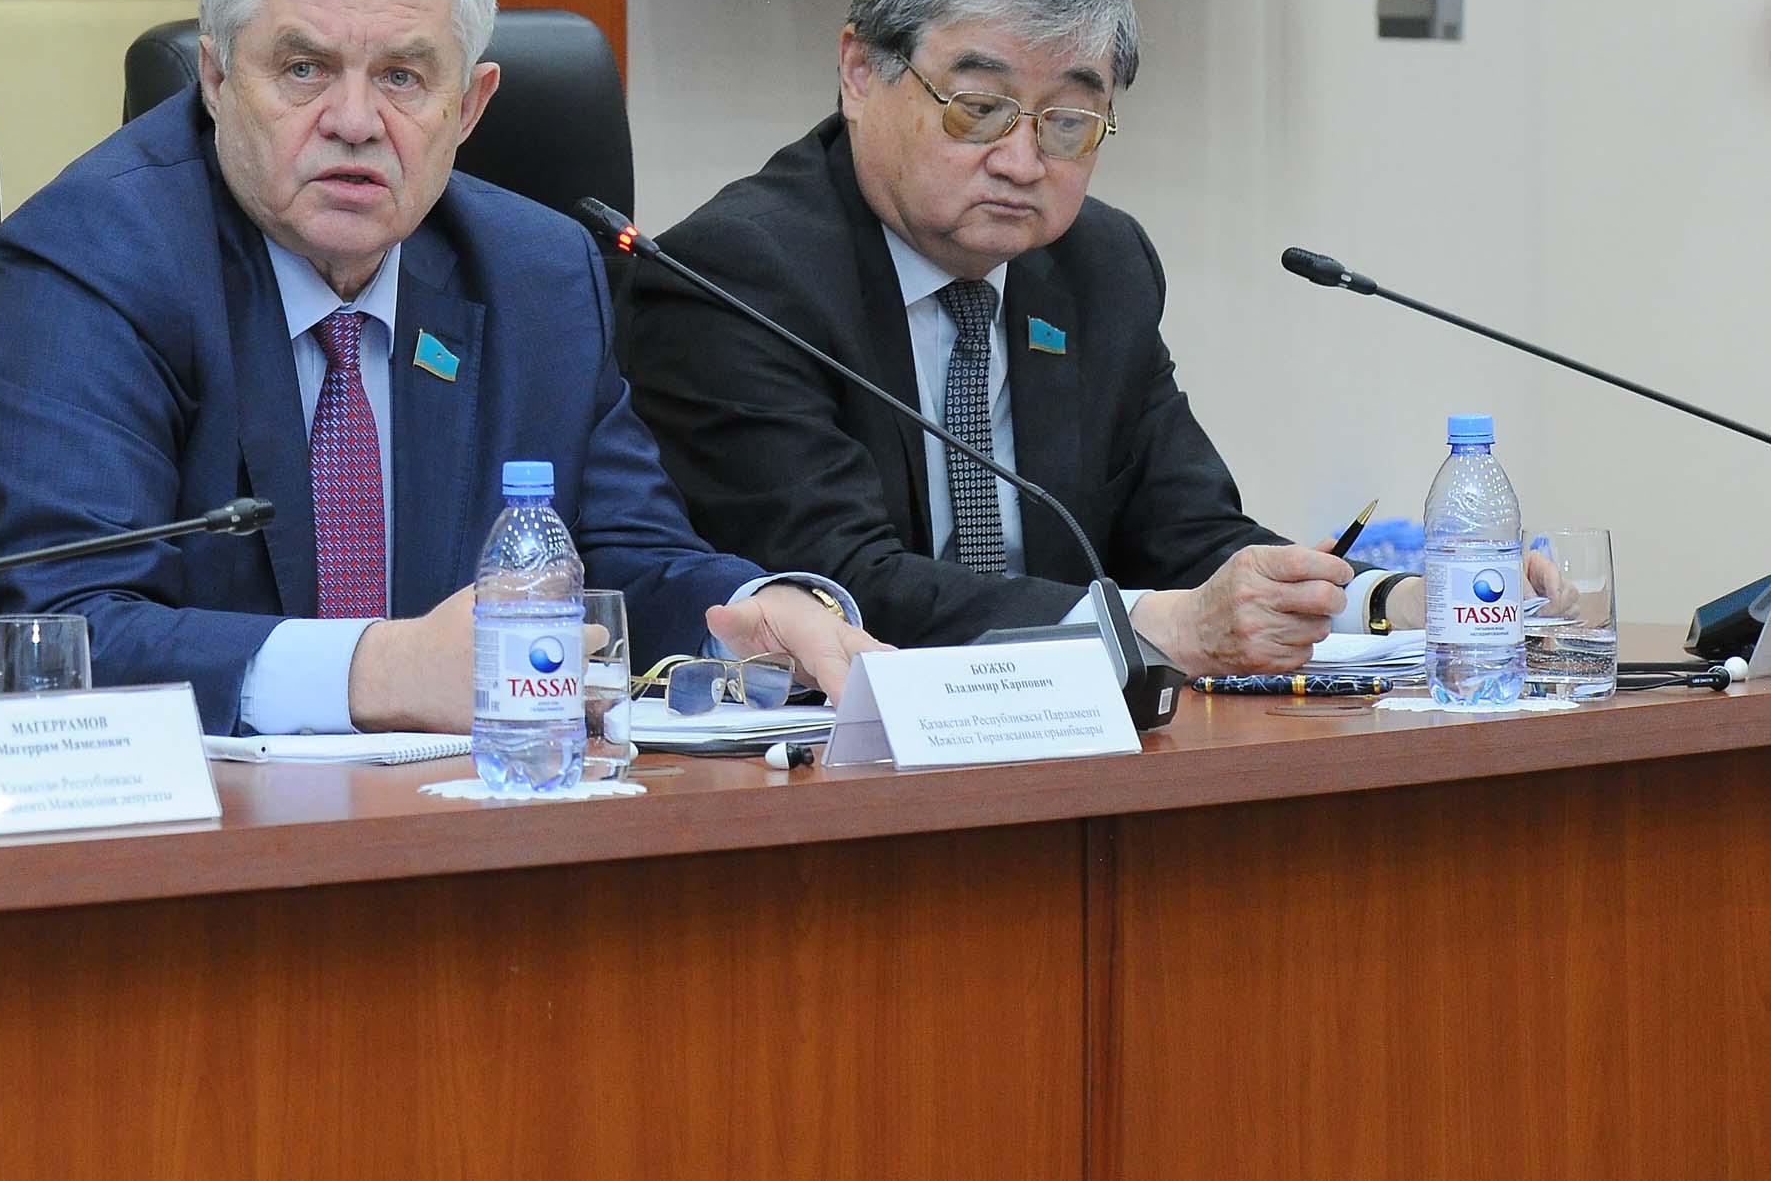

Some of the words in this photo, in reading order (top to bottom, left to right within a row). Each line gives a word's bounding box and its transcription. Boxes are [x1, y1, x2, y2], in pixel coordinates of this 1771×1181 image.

[1453, 605, 1518, 624] TASSAY
[970, 662, 1016, 675] БОЖКО
[507, 677, 579, 698] TASSAY
[945, 682, 999, 694] Владимир
[1000, 678, 1053, 691] Карпович
[11, 716, 108, 734] МАГЕРРАМОВ
